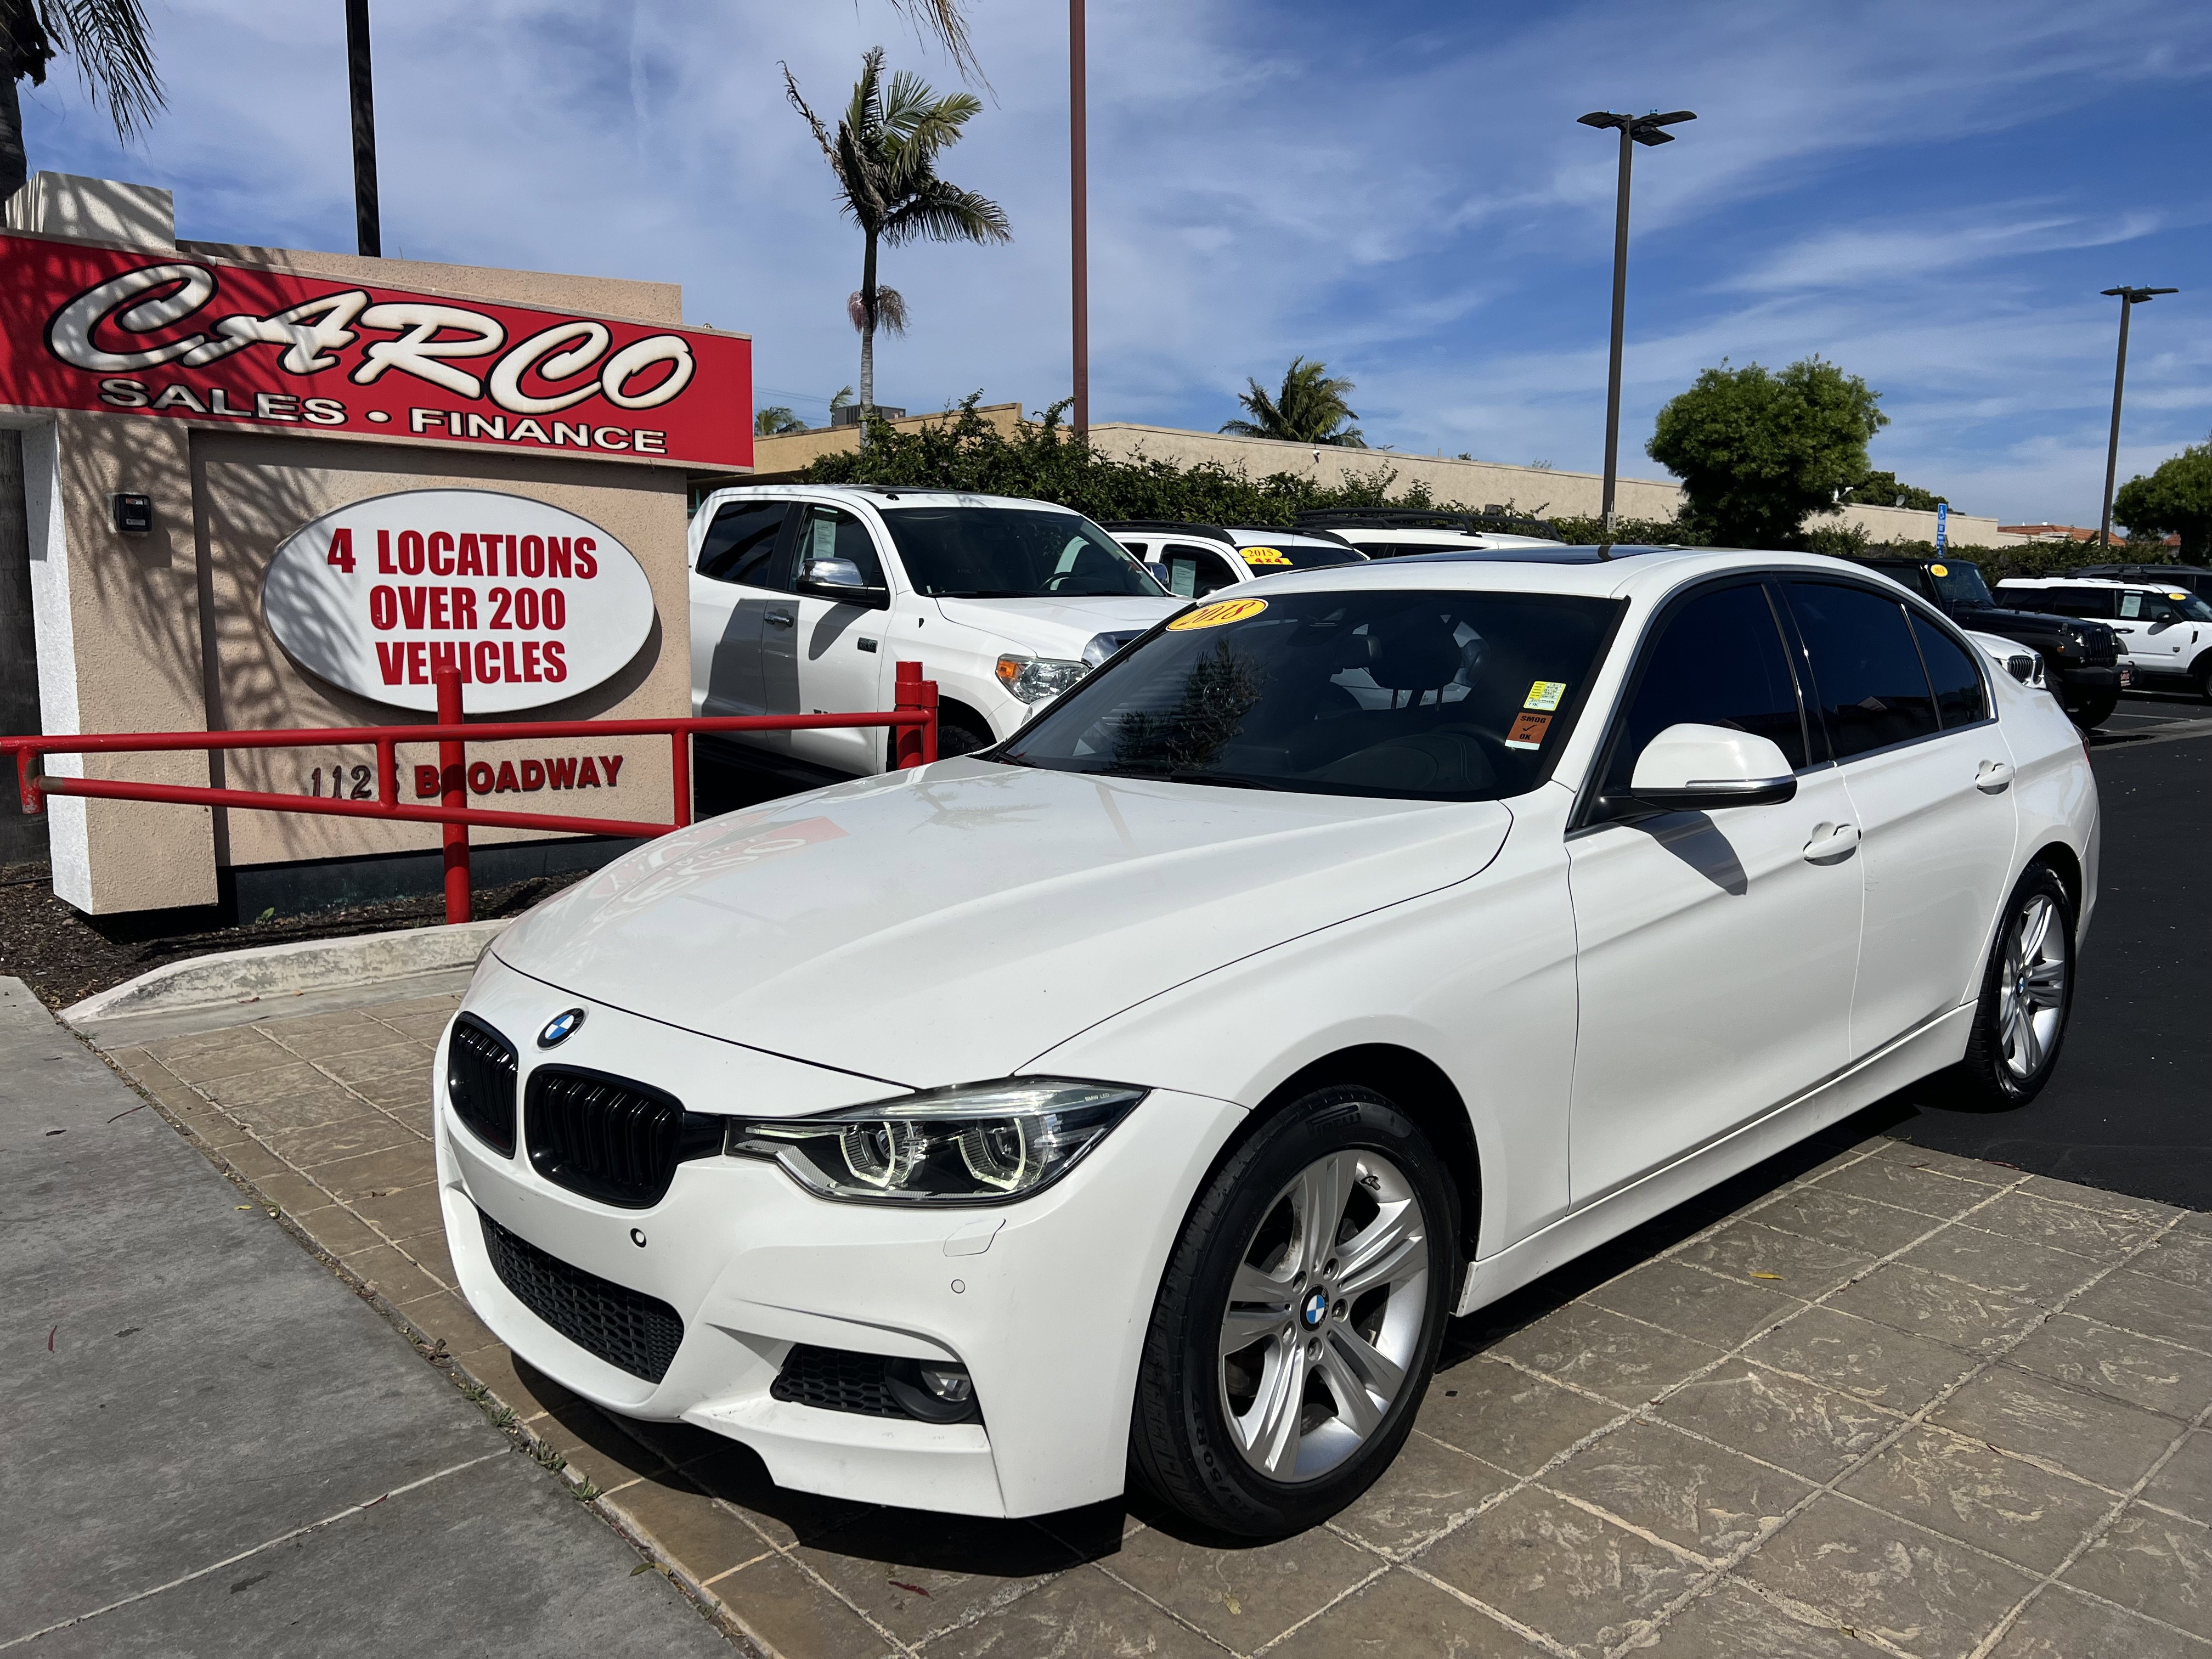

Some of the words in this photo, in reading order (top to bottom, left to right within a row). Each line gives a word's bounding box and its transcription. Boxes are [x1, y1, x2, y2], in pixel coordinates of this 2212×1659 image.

[45, 262, 697, 413] CARCO
[98, 377, 348, 426] SALES
[409, 407, 668, 455] FINANCE
[328, 528, 356, 574] 4
[377, 529, 598, 580] LOCATIONS
[370, 585, 478, 631] OVER
[488, 587, 566, 630] 200
[1176, 601, 1256, 627] 2018
[375, 640, 568, 685] VEHICLES
[1520, 715, 1547, 724] SMOG
[312, 759, 400, 801] 112
[414, 755, 623, 799] BOADWAY
